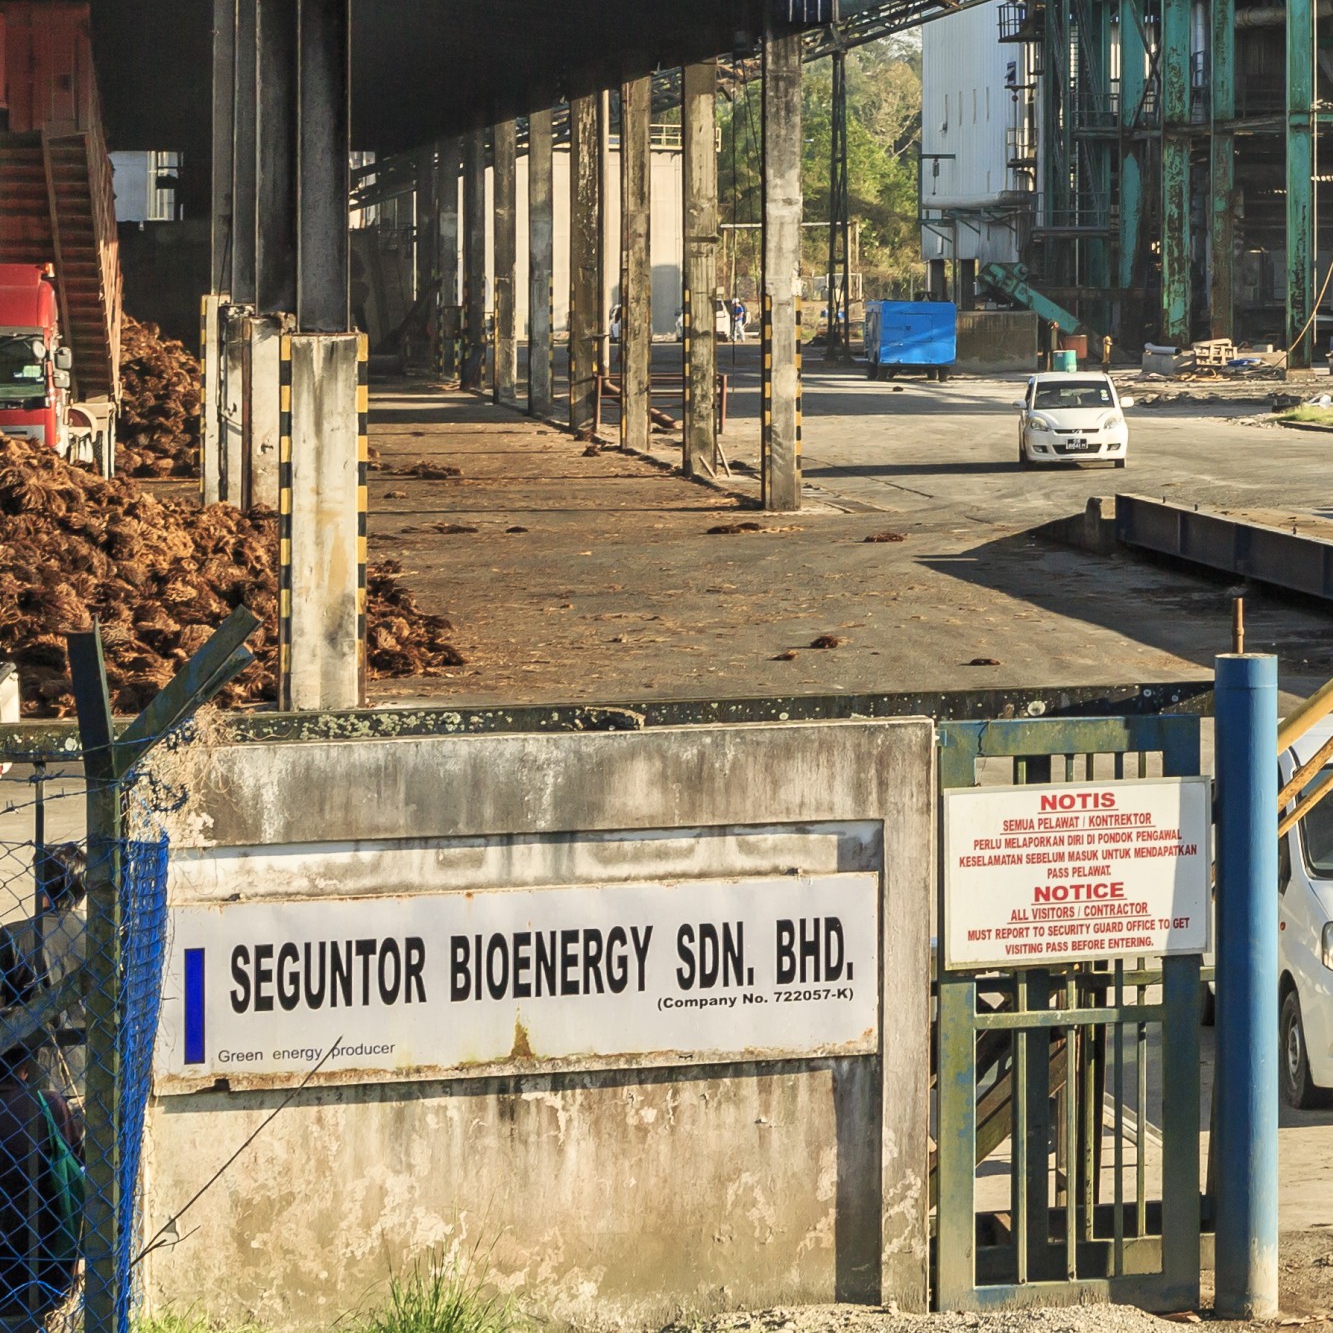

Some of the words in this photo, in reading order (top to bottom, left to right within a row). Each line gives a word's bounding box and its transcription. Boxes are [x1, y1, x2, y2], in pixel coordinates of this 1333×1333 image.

[1041, 792, 1115, 810] NOTIS
[1003, 819, 1034, 831] SEMUA
[1038, 816, 1079, 829] PELAWAT
[1089, 813, 1151, 827] KONTREKTOR
[974, 839, 1001, 850] PERLU
[1004, 835, 1064, 849] MELAPORKAN
[1068, 834, 1083, 845] DIRI
[1087, 833, 1094, 845] DI
[1098, 831, 1132, 844] PONDOK
[1136, 829, 1182, 842] PENGAWAL
[960, 853, 1022, 867] KESELAMATAN
[1026, 851, 1065, 864] SEBELUM
[1068, 849, 1098, 862] MASUK
[1102, 848, 1131, 860] UNTUK
[1134, 844, 1197, 858] MENDAPATKAN
[1047, 868, 1069, 879] PASS
[1072, 865, 1111, 877] PELAWAT.
[1034, 882, 1124, 902] NOTICE
[1011, 909, 1028, 921] ALL
[1032, 906, 1074, 920] VISITORS
[1084, 902, 1148, 917] CONTRACTOR
[968, 929, 992, 941] MUST
[995, 927, 1029, 939] REPORT
[1032, 927, 1045, 937] TO
[1048, 924, 1090, 936] SECURITY
[1093, 922, 1123, 934] GUARD
[1126, 920, 1155, 931] OFFICE
[1158, 919, 1170, 929] TO
[1173, 917, 1190, 929] GET
[1005, 943, 1043, 955] VISITING
[1046, 942, 1068, 952] PASS
[1072, 939, 1105, 951] BEFORE
[1108, 937, 1153, 948] ENTERING.
[230, 936, 427, 1014] SEGUNTOR
[451, 925, 653, 1002] BIOENERGY
[676, 921, 754, 991] SDN.
[776, 917, 854, 985] BHD.
[657, 997, 737, 1011] (Company
[742, 993, 768, 1004] No.
[774, 988, 854, 1003] 722057-K)
[218, 1050, 263, 1063] Green
[272, 1048, 322, 1061] energy
[331, 1043, 395, 1059] producer
